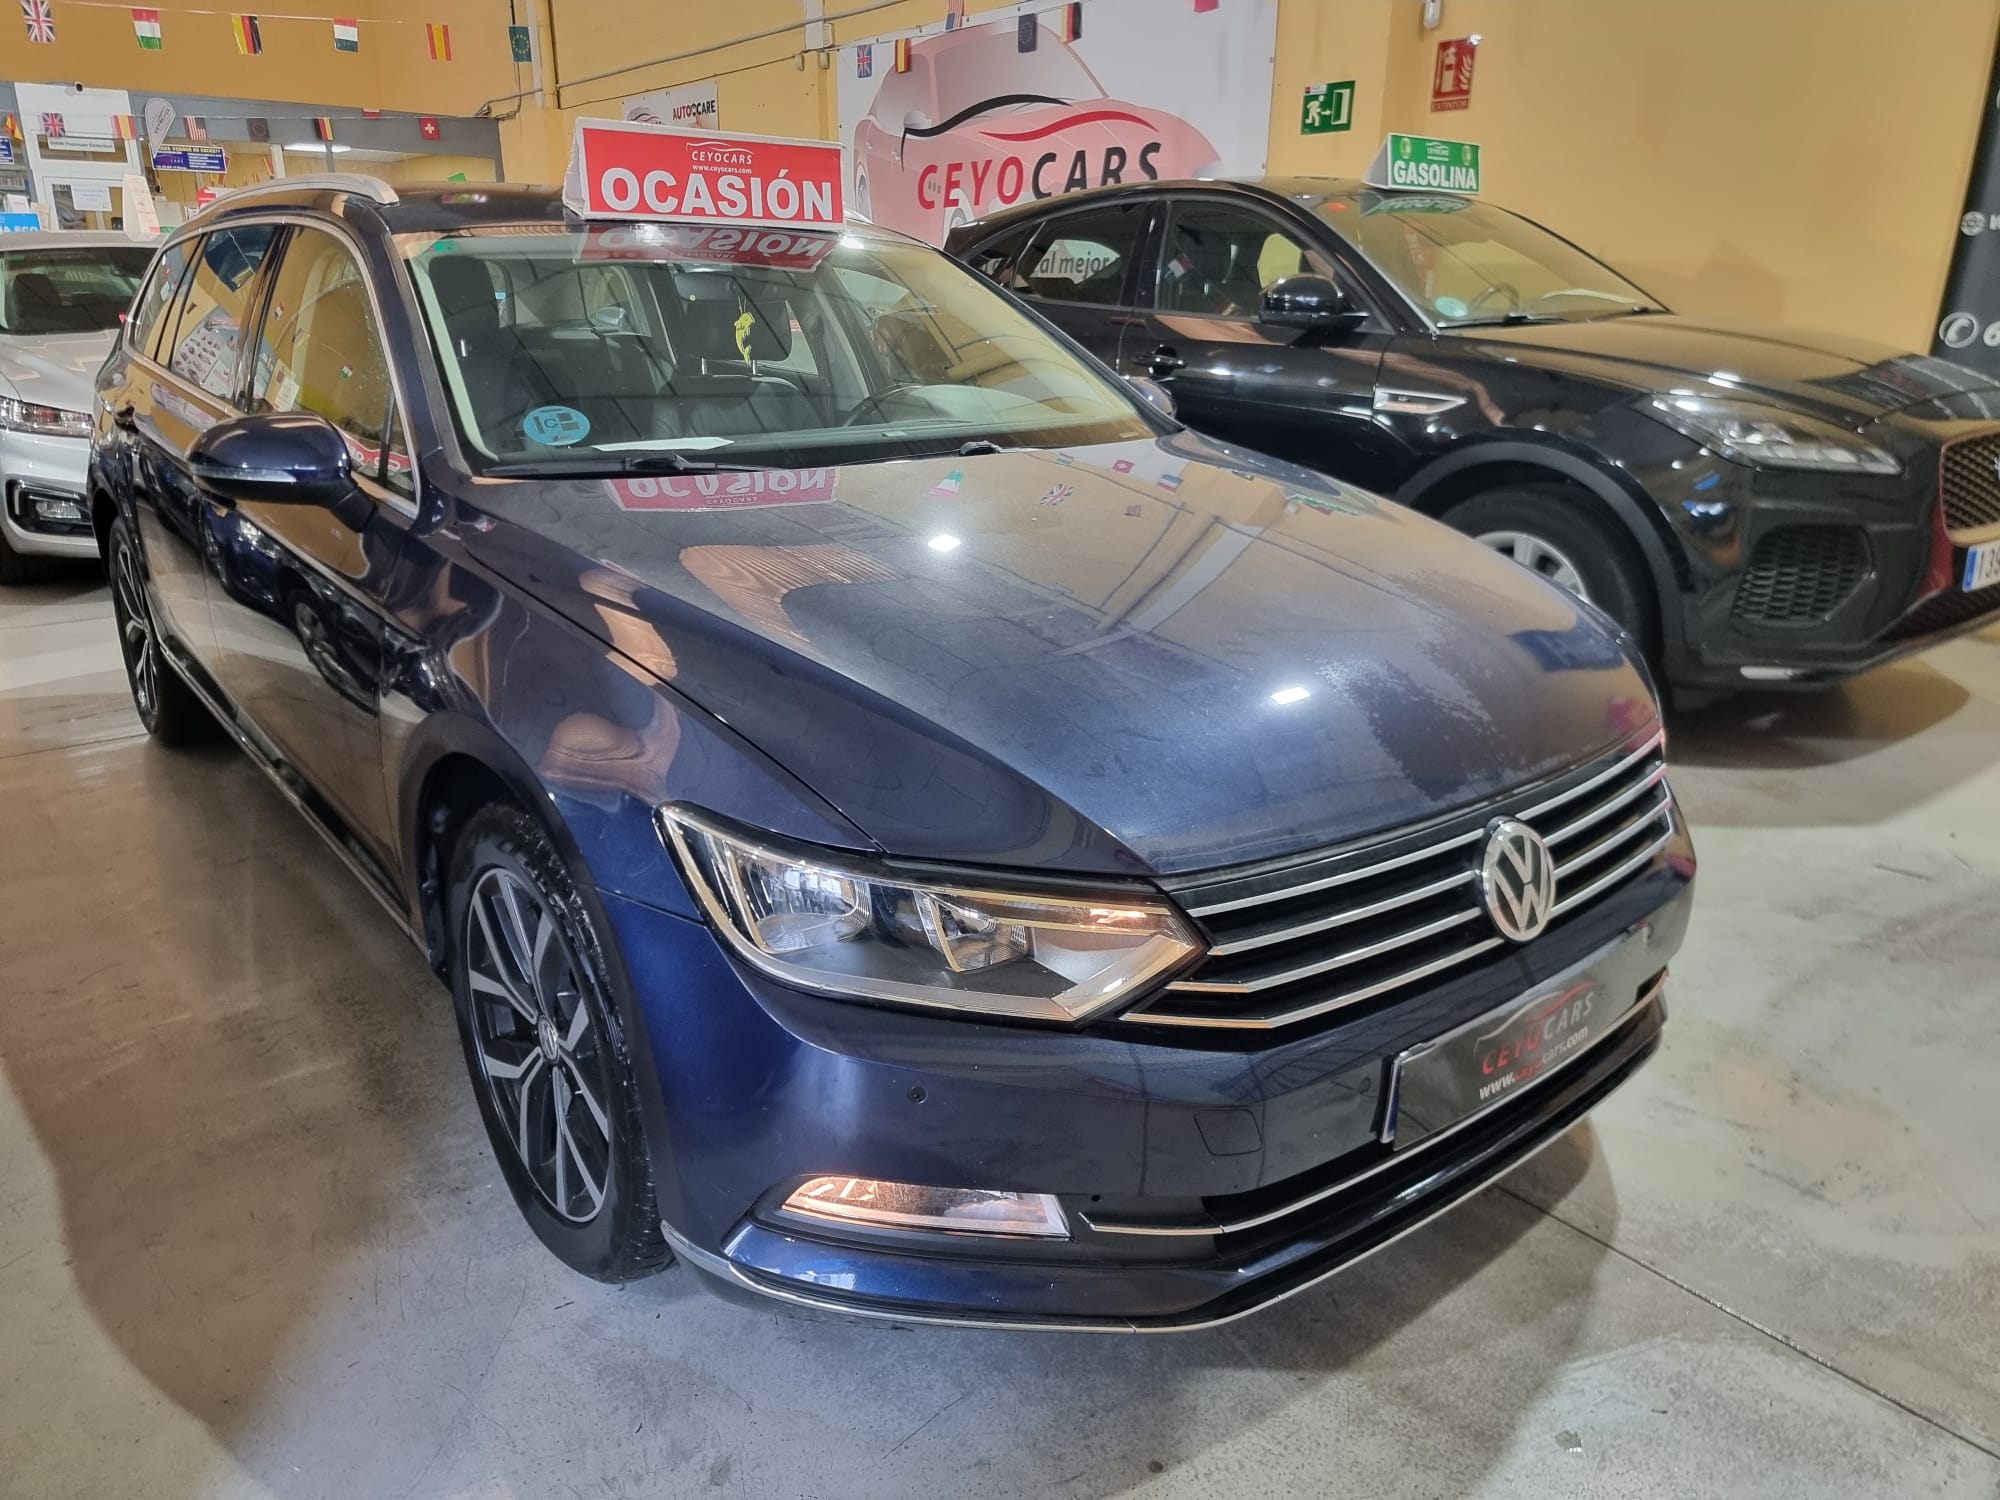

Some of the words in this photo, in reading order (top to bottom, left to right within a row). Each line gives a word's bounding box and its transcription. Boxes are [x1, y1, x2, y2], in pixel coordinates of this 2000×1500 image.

[691, 150, 753, 165] CEYOCARS
[692, 164, 752, 174] www.ceyocars.com
[916, 141, 1162, 210] CEYOCARS
[1393, 159, 1477, 190] GASOLINA
[601, 167, 833, 221] OCASIÓN
[1058, 251, 1110, 278] mejor
[1481, 991, 1594, 1075] CEYOCARS
